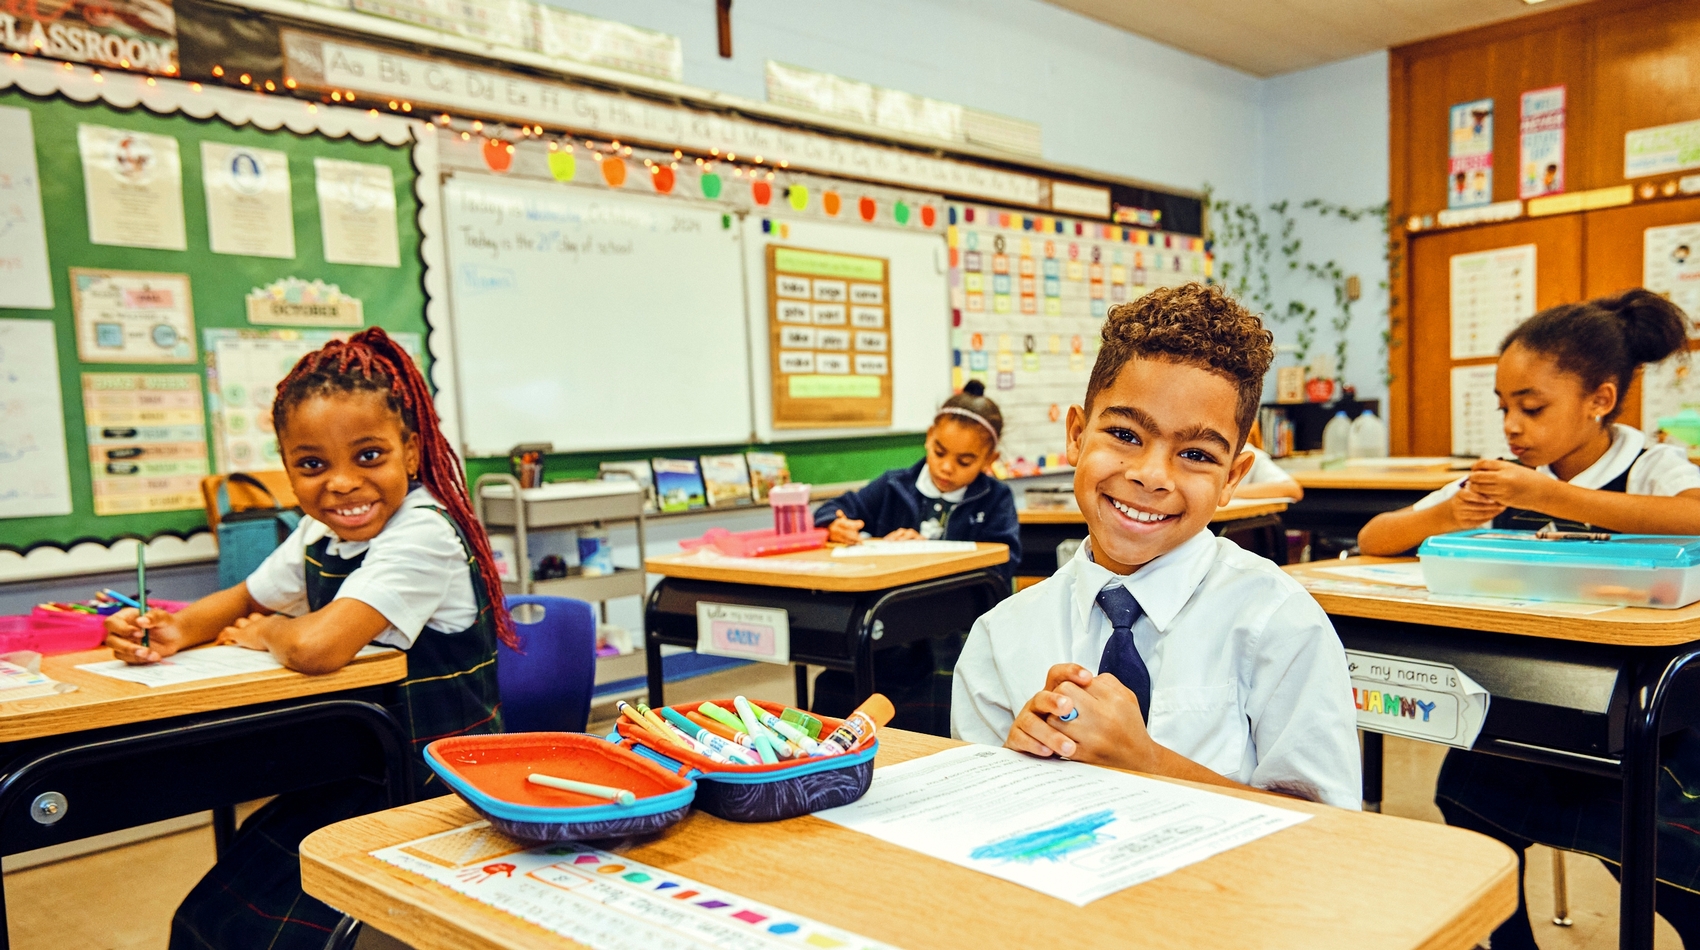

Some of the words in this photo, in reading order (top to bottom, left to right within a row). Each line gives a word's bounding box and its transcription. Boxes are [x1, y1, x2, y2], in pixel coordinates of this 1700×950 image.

[0, 12, 174, 71] LASSROOM
[1370, 664, 1391, 681] my
[1397, 669, 1438, 685] name
[1445, 675, 1457, 688] is
